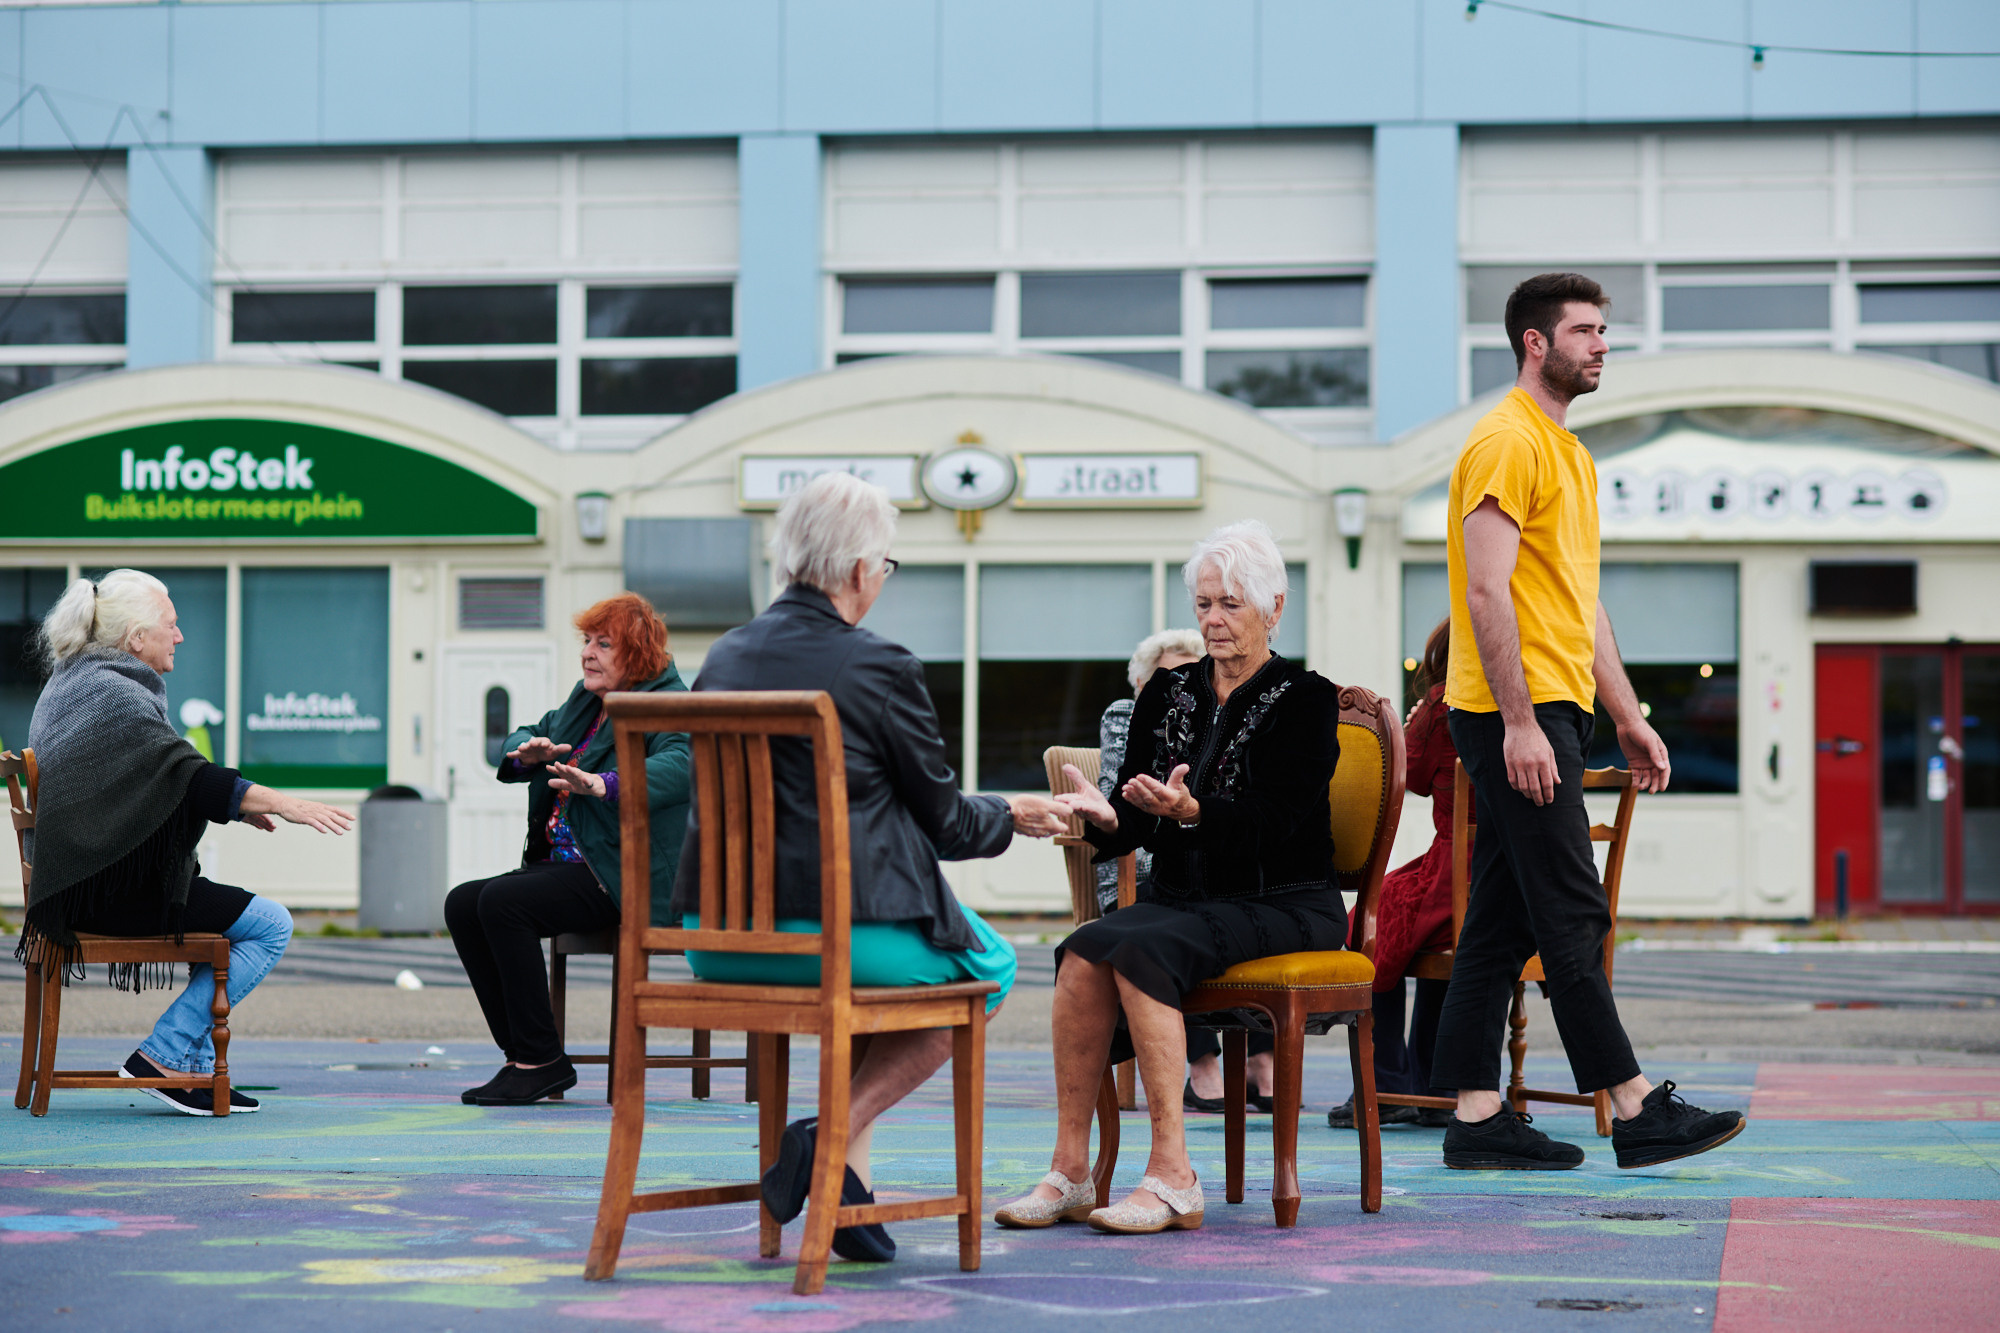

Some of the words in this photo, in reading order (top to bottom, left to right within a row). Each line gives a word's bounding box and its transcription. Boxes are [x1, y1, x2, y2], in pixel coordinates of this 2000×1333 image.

[120, 445, 314, 491] InfoStek
[84, 492, 364, 525] Buikslotermeerplein
[264, 692, 357, 717] InfoStek
